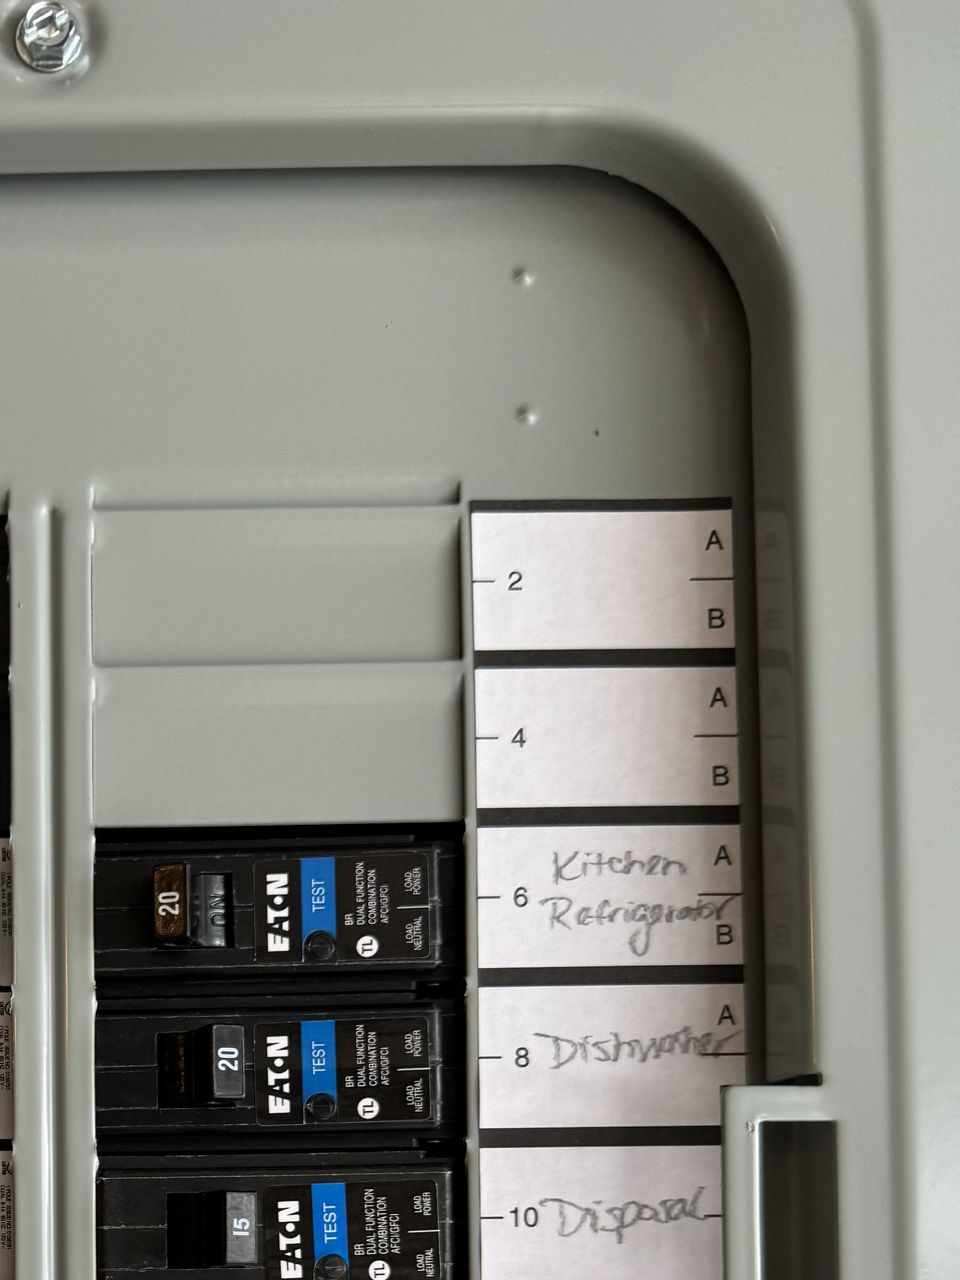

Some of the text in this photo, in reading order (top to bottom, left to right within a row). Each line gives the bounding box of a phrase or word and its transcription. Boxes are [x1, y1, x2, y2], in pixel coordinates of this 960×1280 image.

[705, 529, 724, 551] A
[508, 571, 523, 591] 2
[708, 607, 726, 630] B
[709, 686, 729, 708] A
[511, 727, 527, 748] 4
[712, 765, 730, 787] B
[713, 844, 733, 866] A
[553, 851, 686, 884] Kitchen
[413, 868, 421, 895] POWER
[158, 892, 179, 916] 20
[312, 879, 325, 912] TEST
[355, 862, 365, 925] DUAL FUNCTION
[368, 869, 377, 924] COMBINATION
[513, 886, 529, 908] 6
[266, 873, 290, 952] EATON
[345, 913, 353, 925] BR
[414, 916, 423, 950] NEUTRAL
[716, 923, 734, 946] B
[717, 1004, 736, 1026] A
[405, 1034, 413, 1053] LOAD
[413, 1030, 421, 1056] POWER
[218, 1048, 238, 1071] 20
[312, 1041, 325, 1075] TEST
[356, 1024, 365, 1087] DUAL FUNCTION
[368, 1032, 377, 1086] COMBINATION
[514, 1046, 530, 1068] 8
[267, 1036, 290, 1113] EATON
[346, 1076, 354, 1087] BR
[415, 1078, 423, 1112] NEUTRAL
[414, 1196, 422, 1213] LOAD
[423, 1192, 431, 1216] POWER
[233, 1218, 249, 1235] 15
[323, 1203, 336, 1244] TEST
[364, 1189, 376, 1254] DUAL FUNCTION
[377, 1197, 388, 1254] COMBINATION
[509, 1206, 539, 1228] 10
[278, 1201, 303, 1278] EATON
[355, 1244, 364, 1255] BR
[417, 1254, 425, 1272] LOAD
[426, 1248, 435, 1277] NEUTRAL
